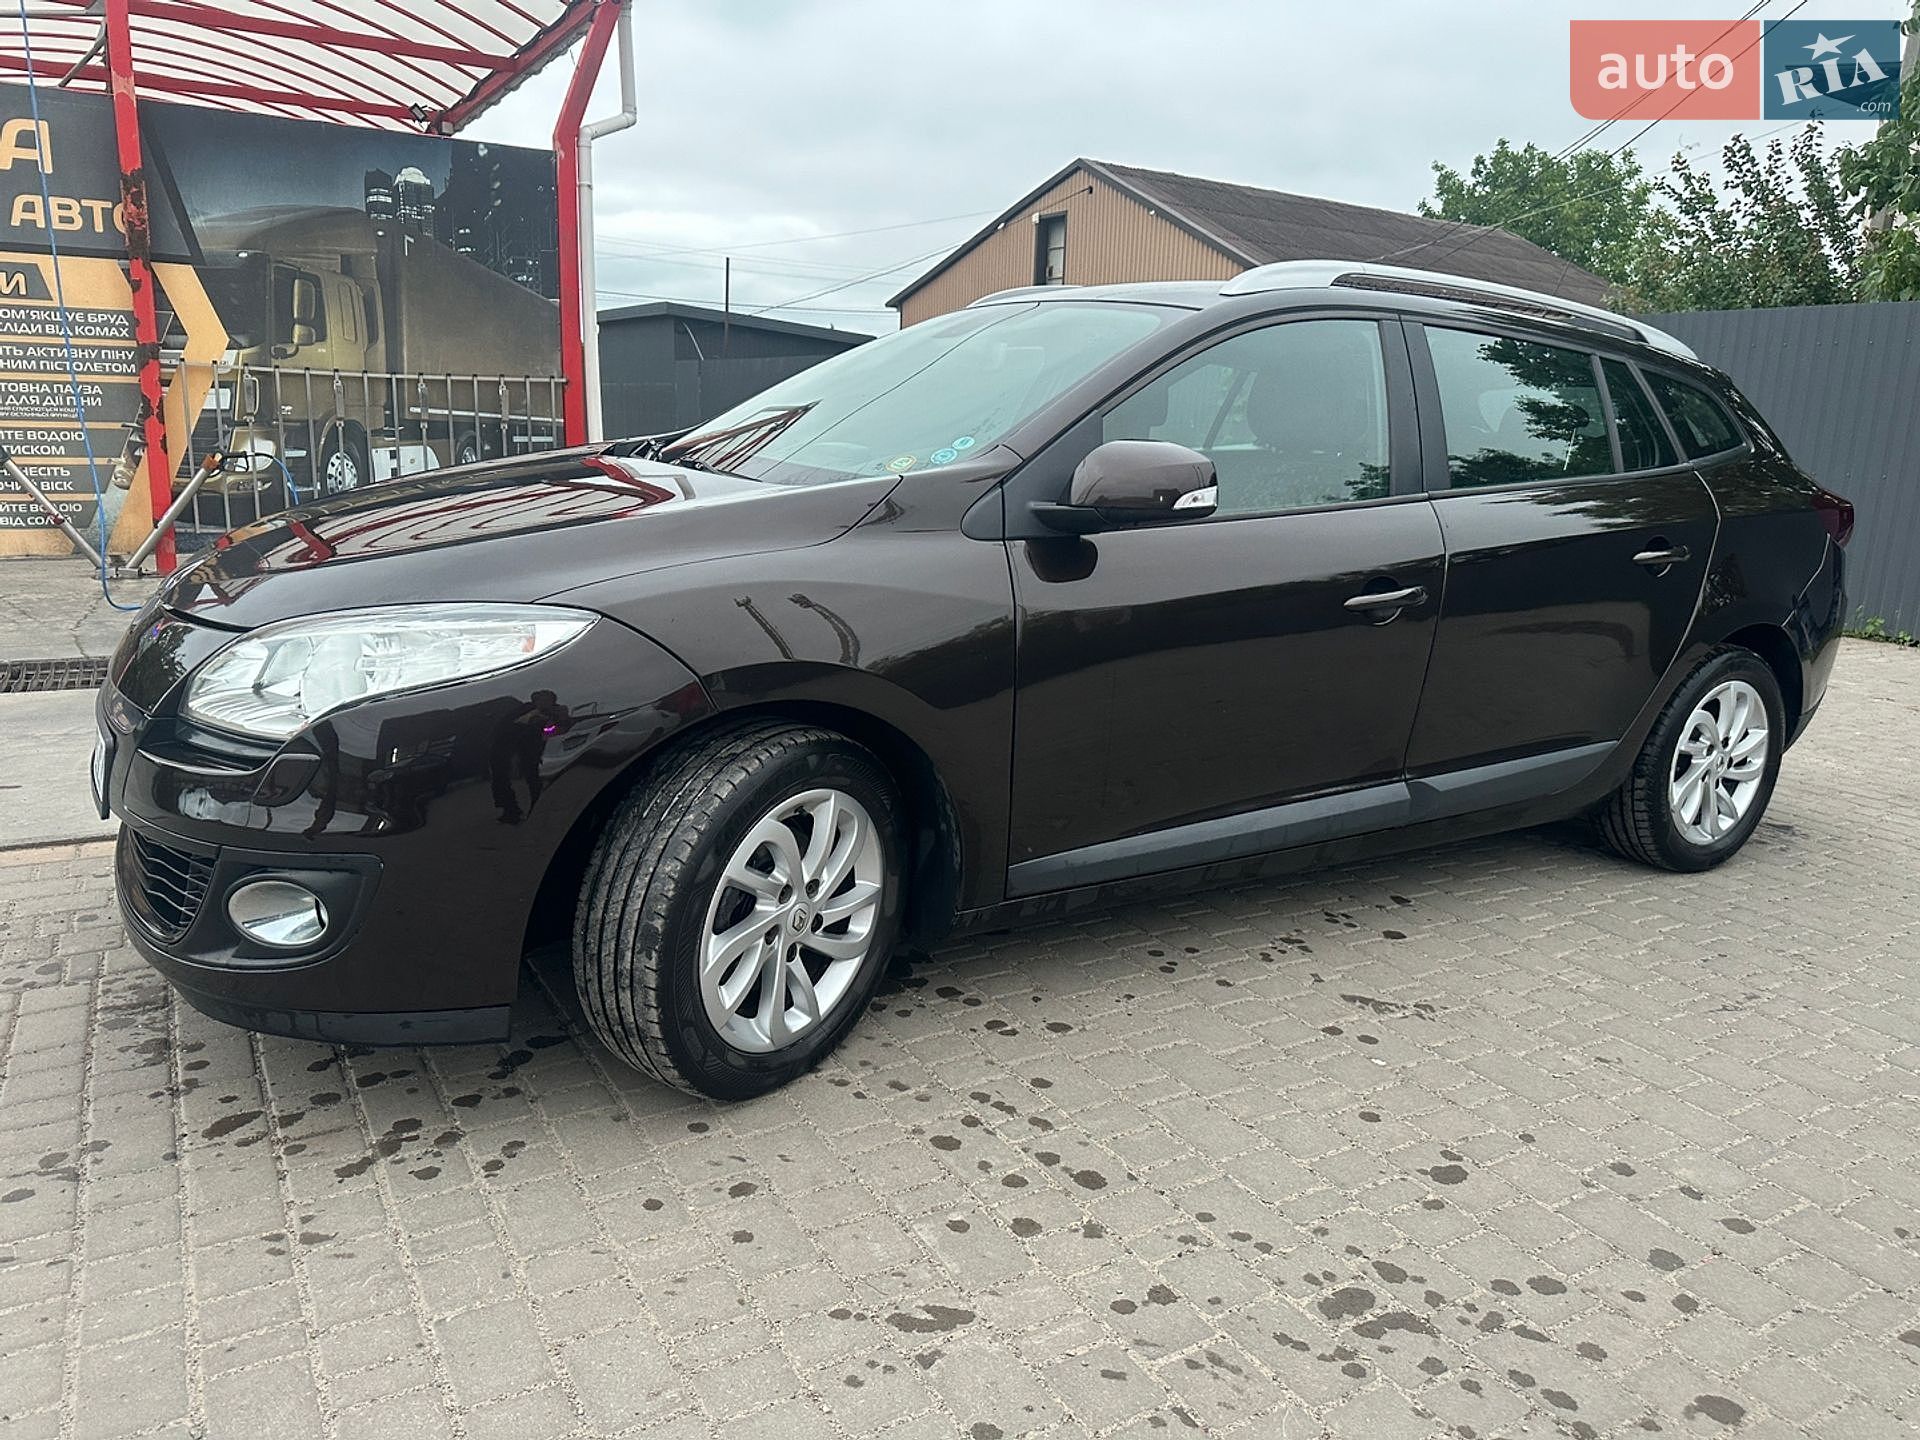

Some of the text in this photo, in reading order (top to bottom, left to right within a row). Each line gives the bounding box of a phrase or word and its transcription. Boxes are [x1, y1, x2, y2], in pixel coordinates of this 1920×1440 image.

[87, 313, 129, 327] БРУД
[45, 324, 73, 337] ВІД
[74, 325, 129, 338] КОМАХ
[26, 346, 98, 360] АКТИВНУ
[101, 350, 135, 361] ПІНУ
[39, 360, 136, 374] ПІСТОЛЕТОМ
[5, 394, 40, 406] ДЛЯ
[66, 396, 102, 406] ПНИ
[26, 430, 85, 442] ВОДОЮ
[41, 481, 75, 491] ВІСК
[29, 503, 83, 513] ВООЮ
